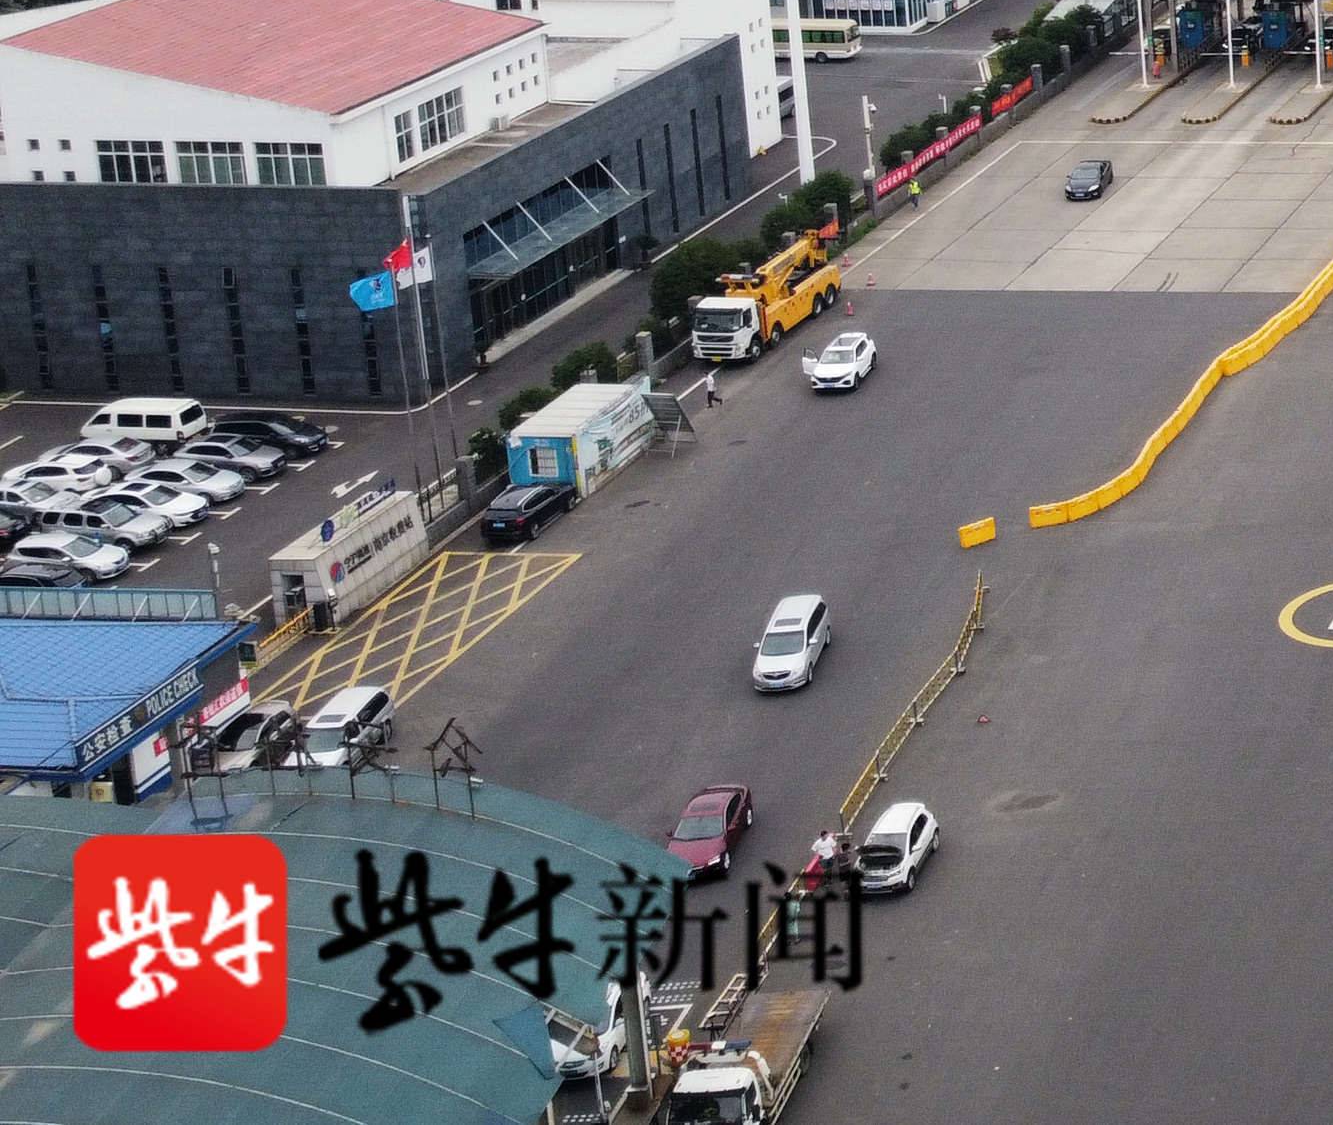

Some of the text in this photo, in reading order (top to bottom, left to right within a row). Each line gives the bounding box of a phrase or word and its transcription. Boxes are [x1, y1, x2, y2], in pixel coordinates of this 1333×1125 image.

[82, 714, 134, 762] 公安检查
[145, 688, 176, 717] POLICE
[174, 667, 200, 697] CHECK
